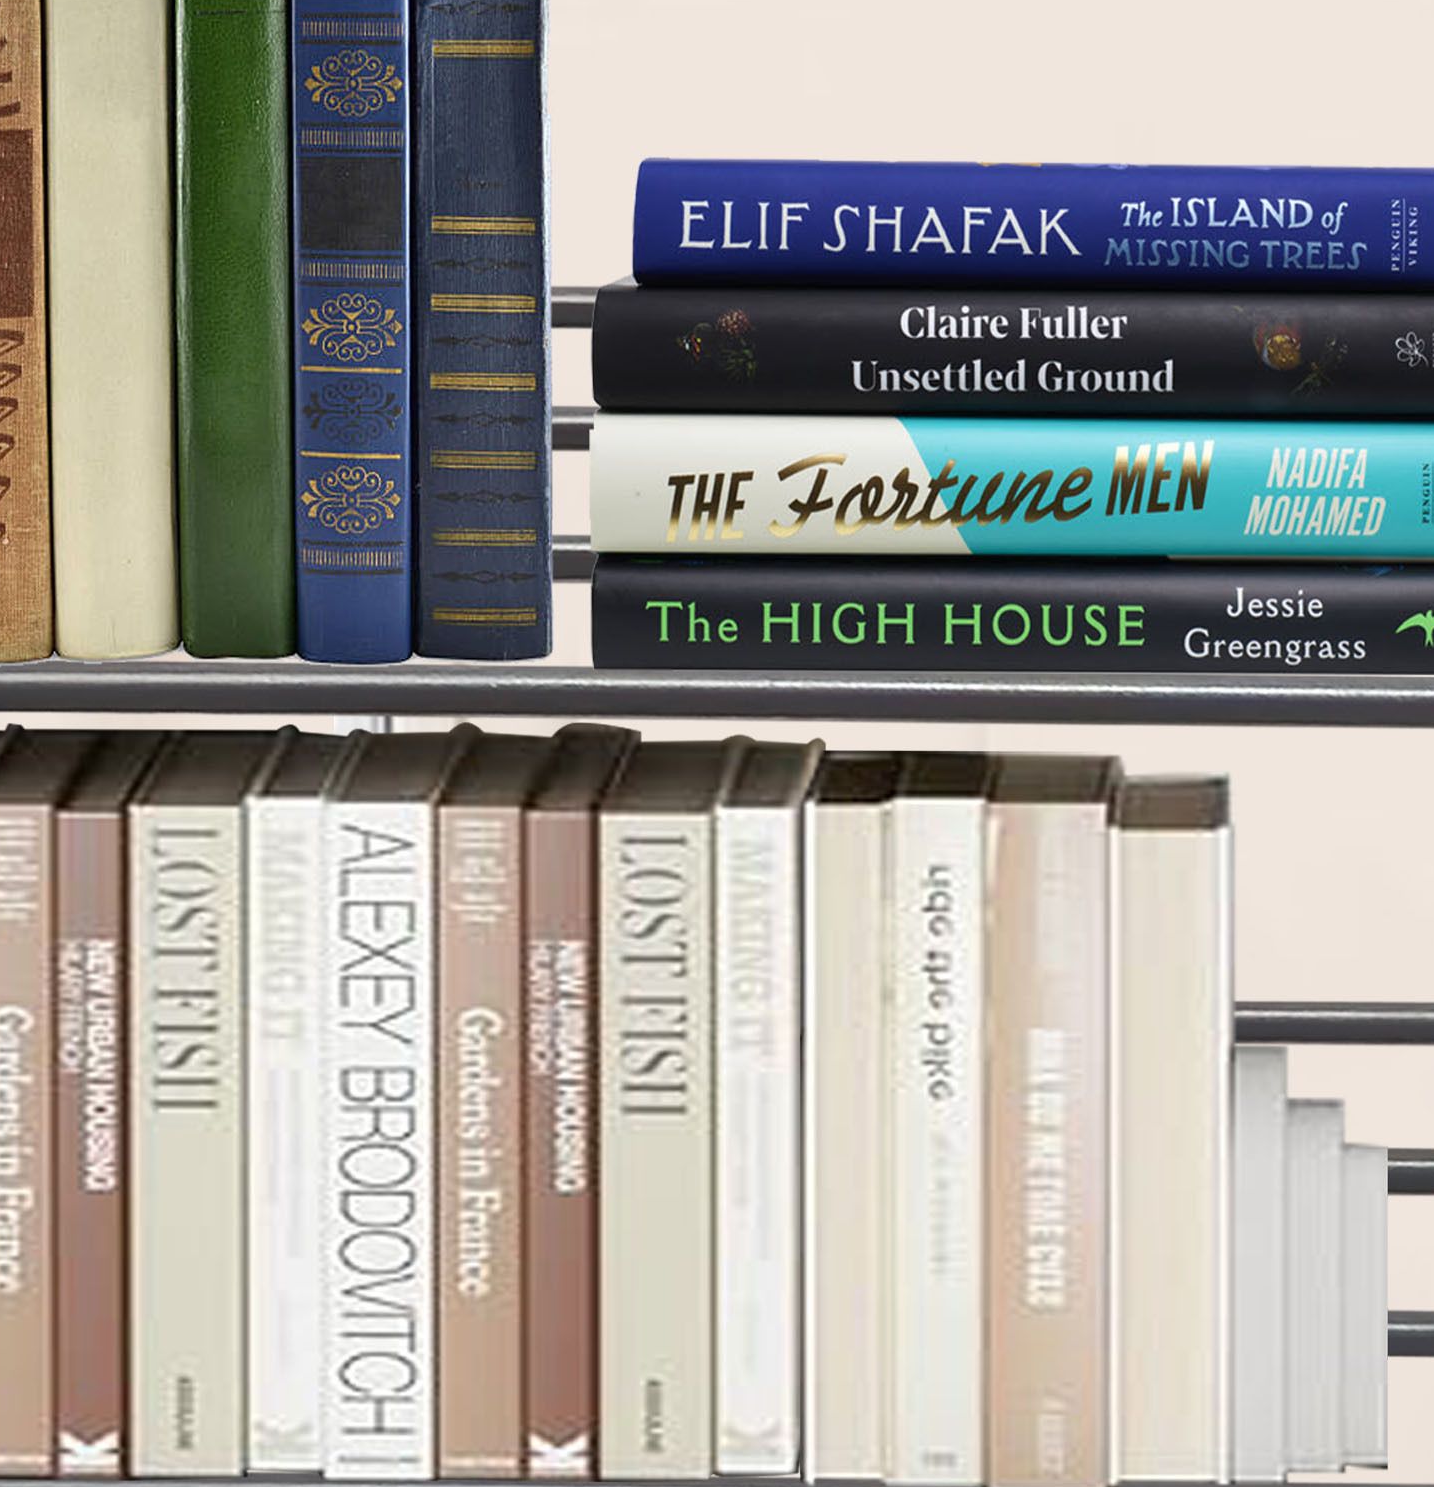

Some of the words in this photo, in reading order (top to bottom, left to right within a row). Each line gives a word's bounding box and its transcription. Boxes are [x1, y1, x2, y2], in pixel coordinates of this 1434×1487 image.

[679, 199, 811, 251] ELIF
[823, 203, 1083, 257] SHAFAK
[1120, 200, 1164, 227] The
[1170, 196, 1314, 230] ISLAND
[1321, 201, 1349, 235] of
[1390, 198, 1401, 272] PENGUIN
[1408, 205, 1419, 267] VIKING
[1104, 238, 1250, 268] MISSING
[1259, 240, 1369, 270] TREES
[899, 303, 1009, 343] Claire
[1019, 303, 1128, 343] Fuller
[851, 357, 1026, 393] Unsettled
[1037, 357, 1174, 394] Ground
[666, 469, 756, 544] THE
[767, 452, 1095, 539] Fortune
[1104, 439, 1216, 517] MEN
[1266, 446, 1368, 491] NADIFA
[1422, 462, 1431, 525] PENGUIN
[1244, 495, 1386, 536] MOHAMED
[645, 601, 739, 645] The
[761, 602, 916, 646] HIGH
[943, 603, 1147, 648] HOUSE
[1226, 586, 1324, 619] Jessie
[1183, 626, 1367, 666] Greengrass
[150, 825, 221, 974] LOST
[619, 834, 690, 980] LOST
[729, 838, 777, 1003] MAKING
[84, 939, 117, 996] NEW
[338, 823, 417, 1046] ALEXEY
[555, 939, 587, 996] NEW
[84, 998, 117, 1079] URBAN
[150, 986, 221, 1114] FISH
[555, 999, 587, 1079] URBAN
[619, 995, 690, 1117] FISH
[457, 1007, 503, 1140] Gardens
[84, 1084, 117, 1191] HOUSING
[458, 1147, 502, 1180] in
[555, 1084, 587, 1192] HOUSING
[337, 1065, 418, 1436] BRODOVITCH
[456, 1188, 503, 1296] France
